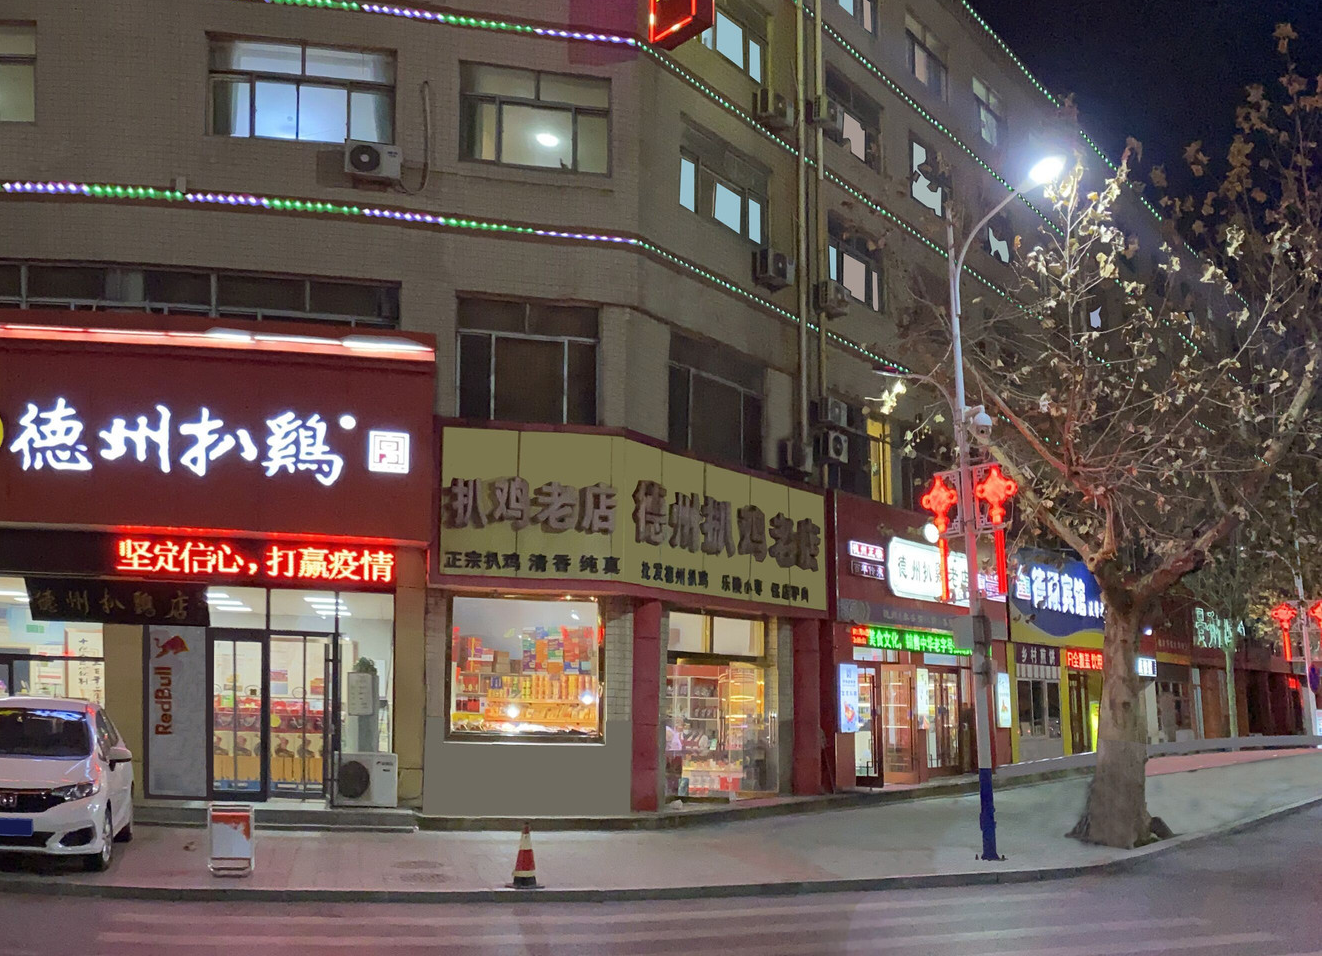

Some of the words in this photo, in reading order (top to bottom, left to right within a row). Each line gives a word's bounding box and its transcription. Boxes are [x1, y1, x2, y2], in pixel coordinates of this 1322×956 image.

[445, 476, 618, 535] 扒鸡老店
[633, 480, 822, 572] 德州扒鸡老店
[444, 551, 521, 572] 正宗扒鸡
[1021, 646, 1056, 665] 乡村煎饼
